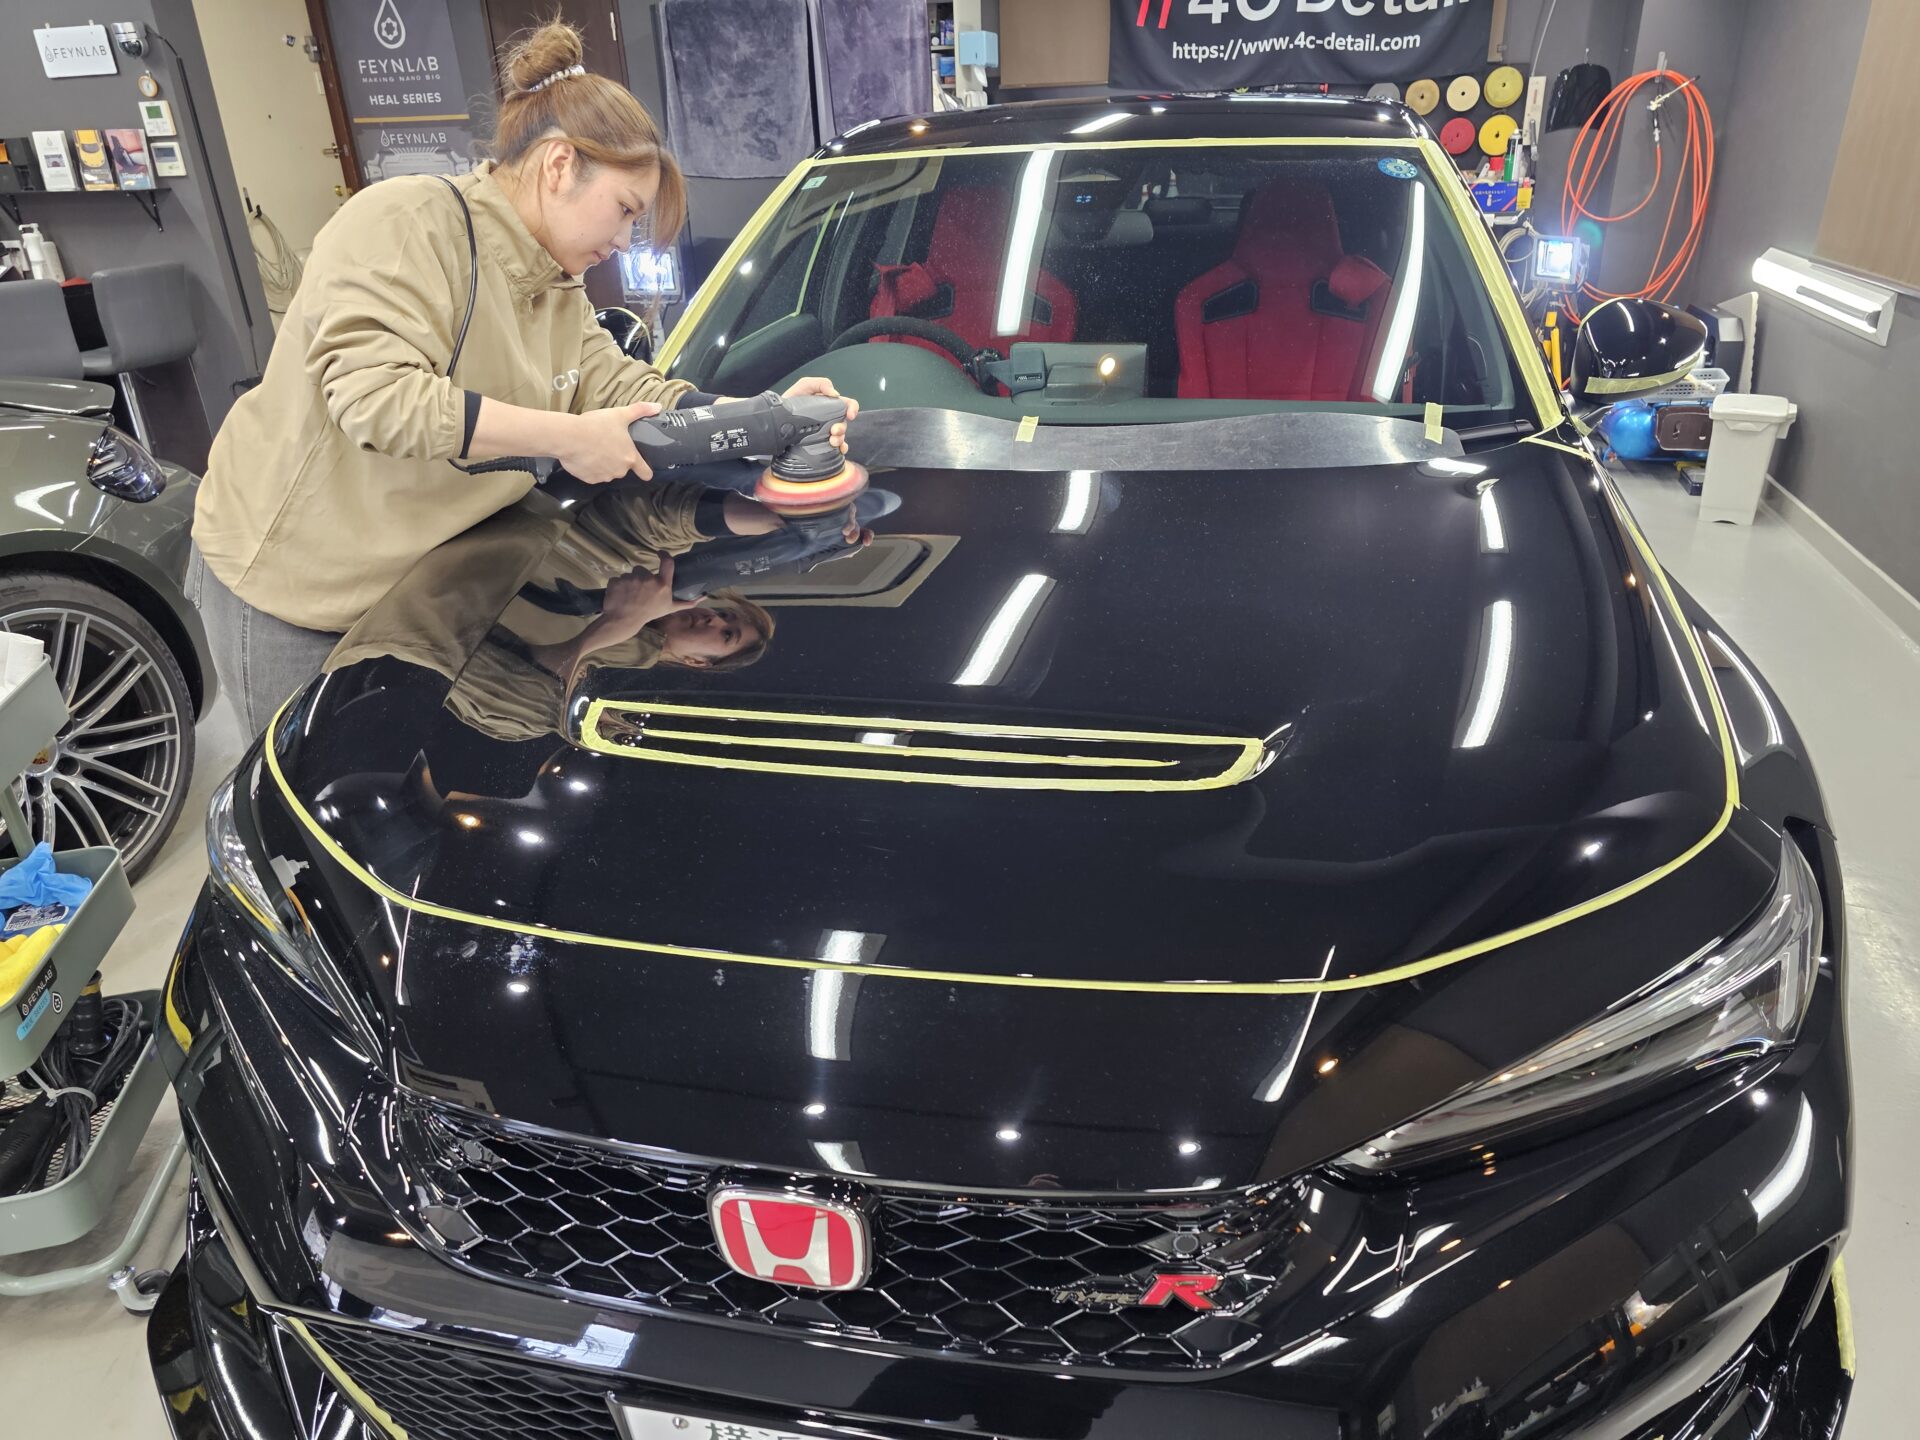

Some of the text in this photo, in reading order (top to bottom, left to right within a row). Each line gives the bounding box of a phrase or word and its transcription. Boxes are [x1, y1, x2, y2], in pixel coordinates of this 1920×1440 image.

[53, 45, 107, 59] FEYNLAB
[1172, 31, 1421, 63] https://www.4c-detail.com
[358, 56, 439, 75] FEYNLAB
[399, 74, 421, 82] NANO
[425, 73, 441, 81] BIG
[369, 92, 442, 106] HEAL SERIES
[389, 132, 447, 145] FEYNLAB
[27, 969, 53, 1007] FEYNLAB
[1138, 1273, 1222, 1311] R
